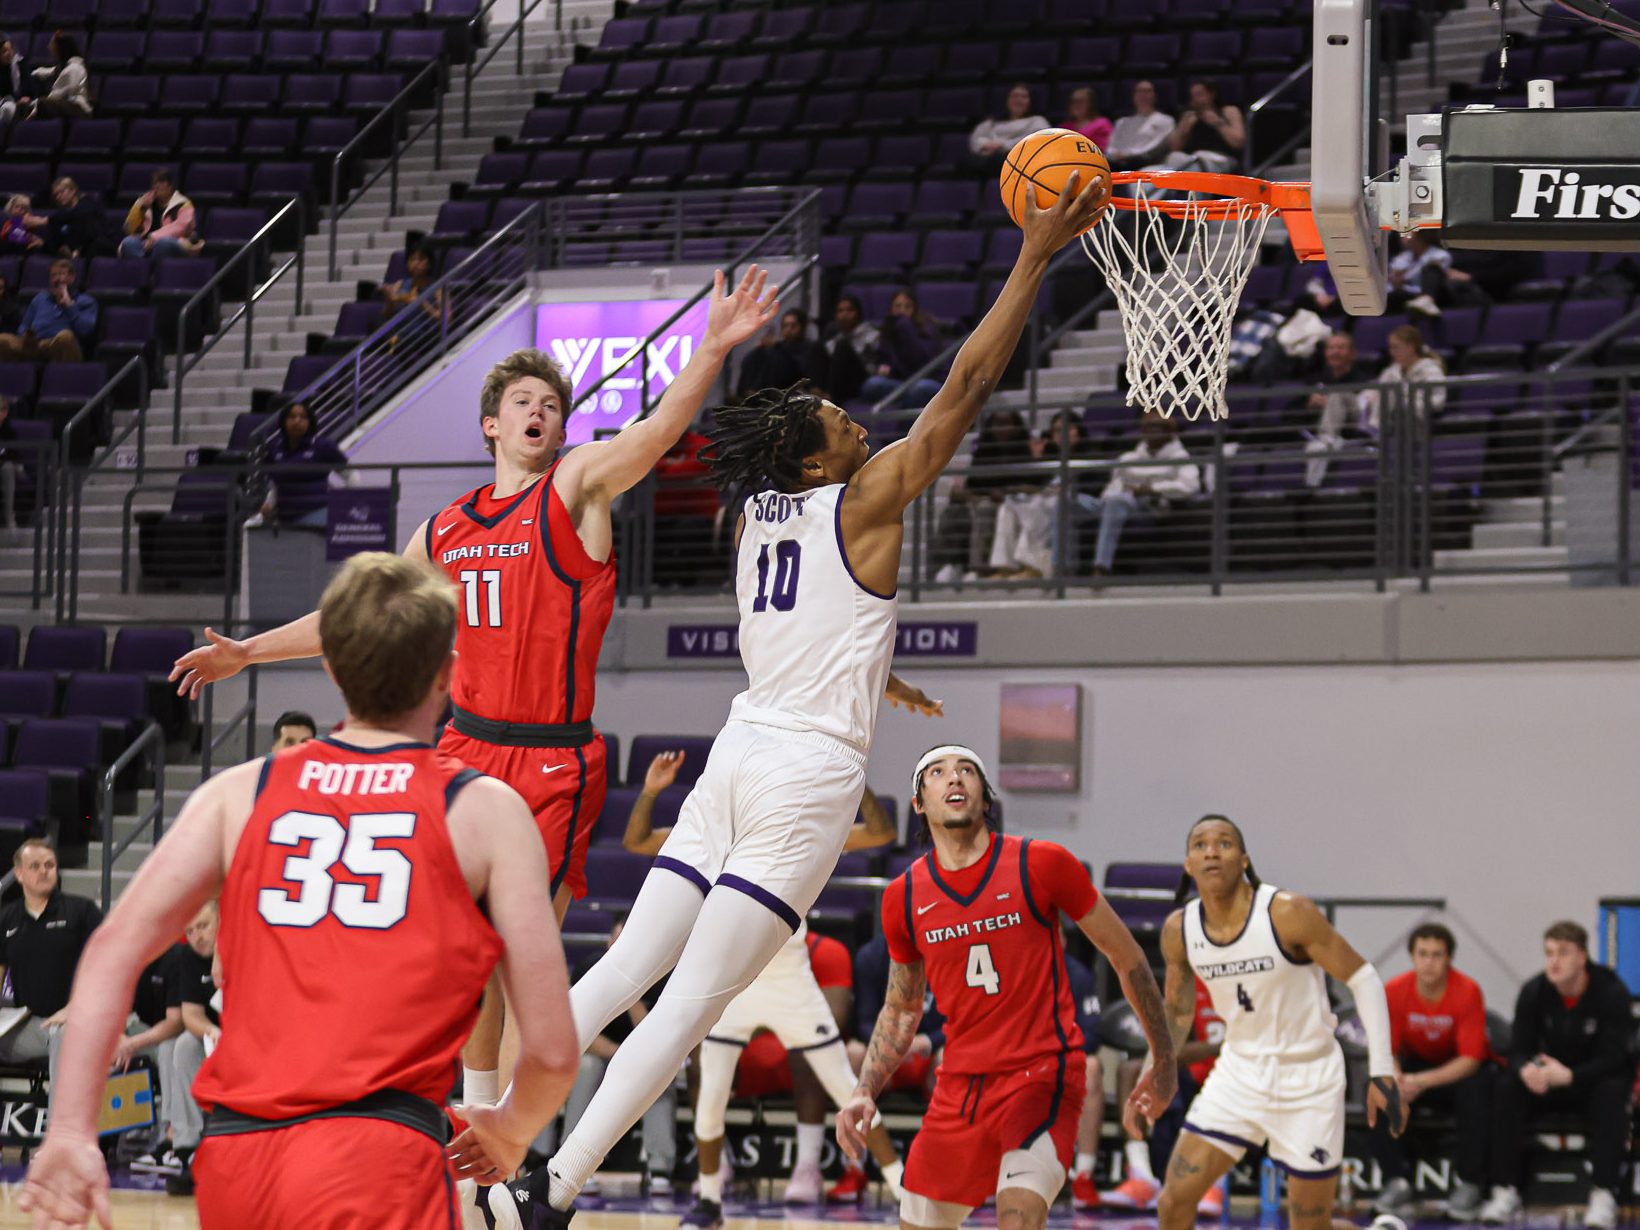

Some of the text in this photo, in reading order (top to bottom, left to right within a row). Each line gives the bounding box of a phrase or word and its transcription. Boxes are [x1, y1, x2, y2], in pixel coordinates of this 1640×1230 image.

[1076, 141, 1101, 155] EV
[1510, 168, 1640, 219] Firs
[754, 493, 811, 524] SCOT
[442, 541, 530, 565] UTAH TECH
[752, 539, 802, 613] 10
[459, 569, 502, 628] 11
[897, 627, 960, 651] ION
[297, 760, 416, 796] POTTER
[256, 809, 418, 931] 35
[925, 911, 1022, 945] UTAH TECH
[965, 943, 1000, 996] 4
[1197, 956, 1275, 980] WILDCATS
[1237, 982, 1256, 1012] 4
